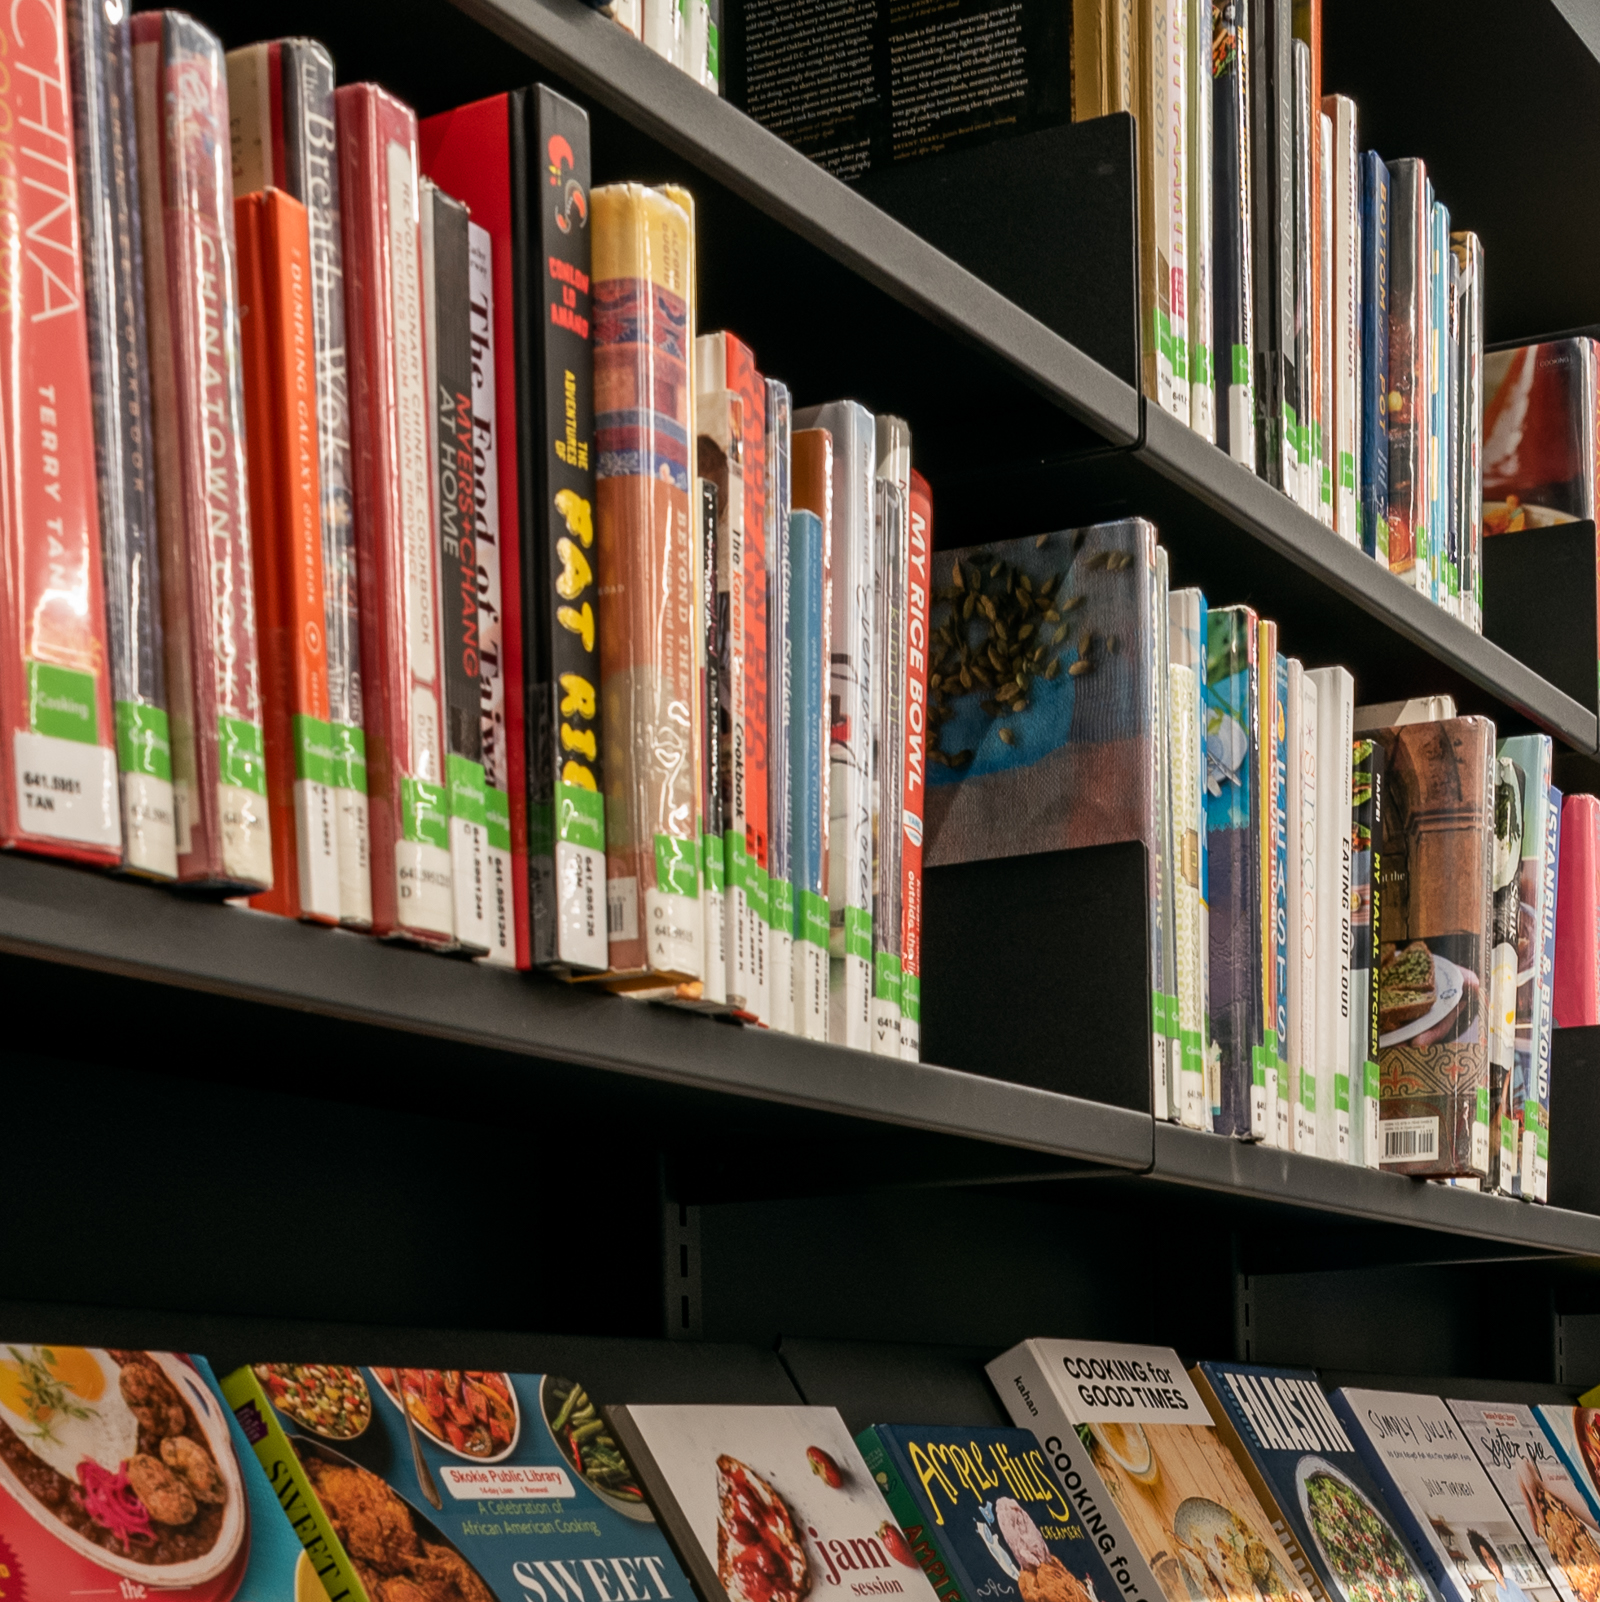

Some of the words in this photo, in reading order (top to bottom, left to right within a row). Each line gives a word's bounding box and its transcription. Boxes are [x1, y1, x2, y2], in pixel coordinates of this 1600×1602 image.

[470, 293, 492, 390] The
[37, 385, 62, 502] TERRY
[473, 406, 498, 546] Food
[554, 488, 595, 653] FAT
[910, 510, 928, 574] MY
[477, 566, 499, 631] of
[909, 578, 926, 674] RICE
[906, 684, 924, 792] BOWL
[1374, 772, 1382, 823] MAFFEI
[1340, 836, 1352, 912] EATING
[1542, 802, 1559, 941] ISTANBUL
[1340, 917, 1351, 957] OUT
[1372, 889, 1383, 960] HALAL
[1339, 964, 1350, 1019] LOUD
[1371, 967, 1382, 1057] KITCHEN
[1539, 985, 1554, 1101] BEYOND
[1225, 1372, 1356, 1454] FALASTIN
[1367, 1409, 1416, 1446] SIMPLY
[1419, 1417, 1459, 1442] JULIA
[449, 1466, 484, 1486] Skokie
[485, 1468, 520, 1486] Public
[522, 1468, 562, 1486] Library
[489, 1499, 548, 1516] Celebration
[551, 1498, 565, 1515] of
[1011, 1374, 1040, 1420] kahan
[1043, 1434, 1119, 1555] COOKING
[1106, 1555, 1139, 1601] for
[462, 1519, 501, 1537] African
[503, 1519, 552, 1536] American
[555, 1518, 602, 1537] Cooking
[808, 1526, 891, 1589] jam
[1040, 1524, 1085, 1541] CREAMERY
[850, 1576, 905, 1598] session
